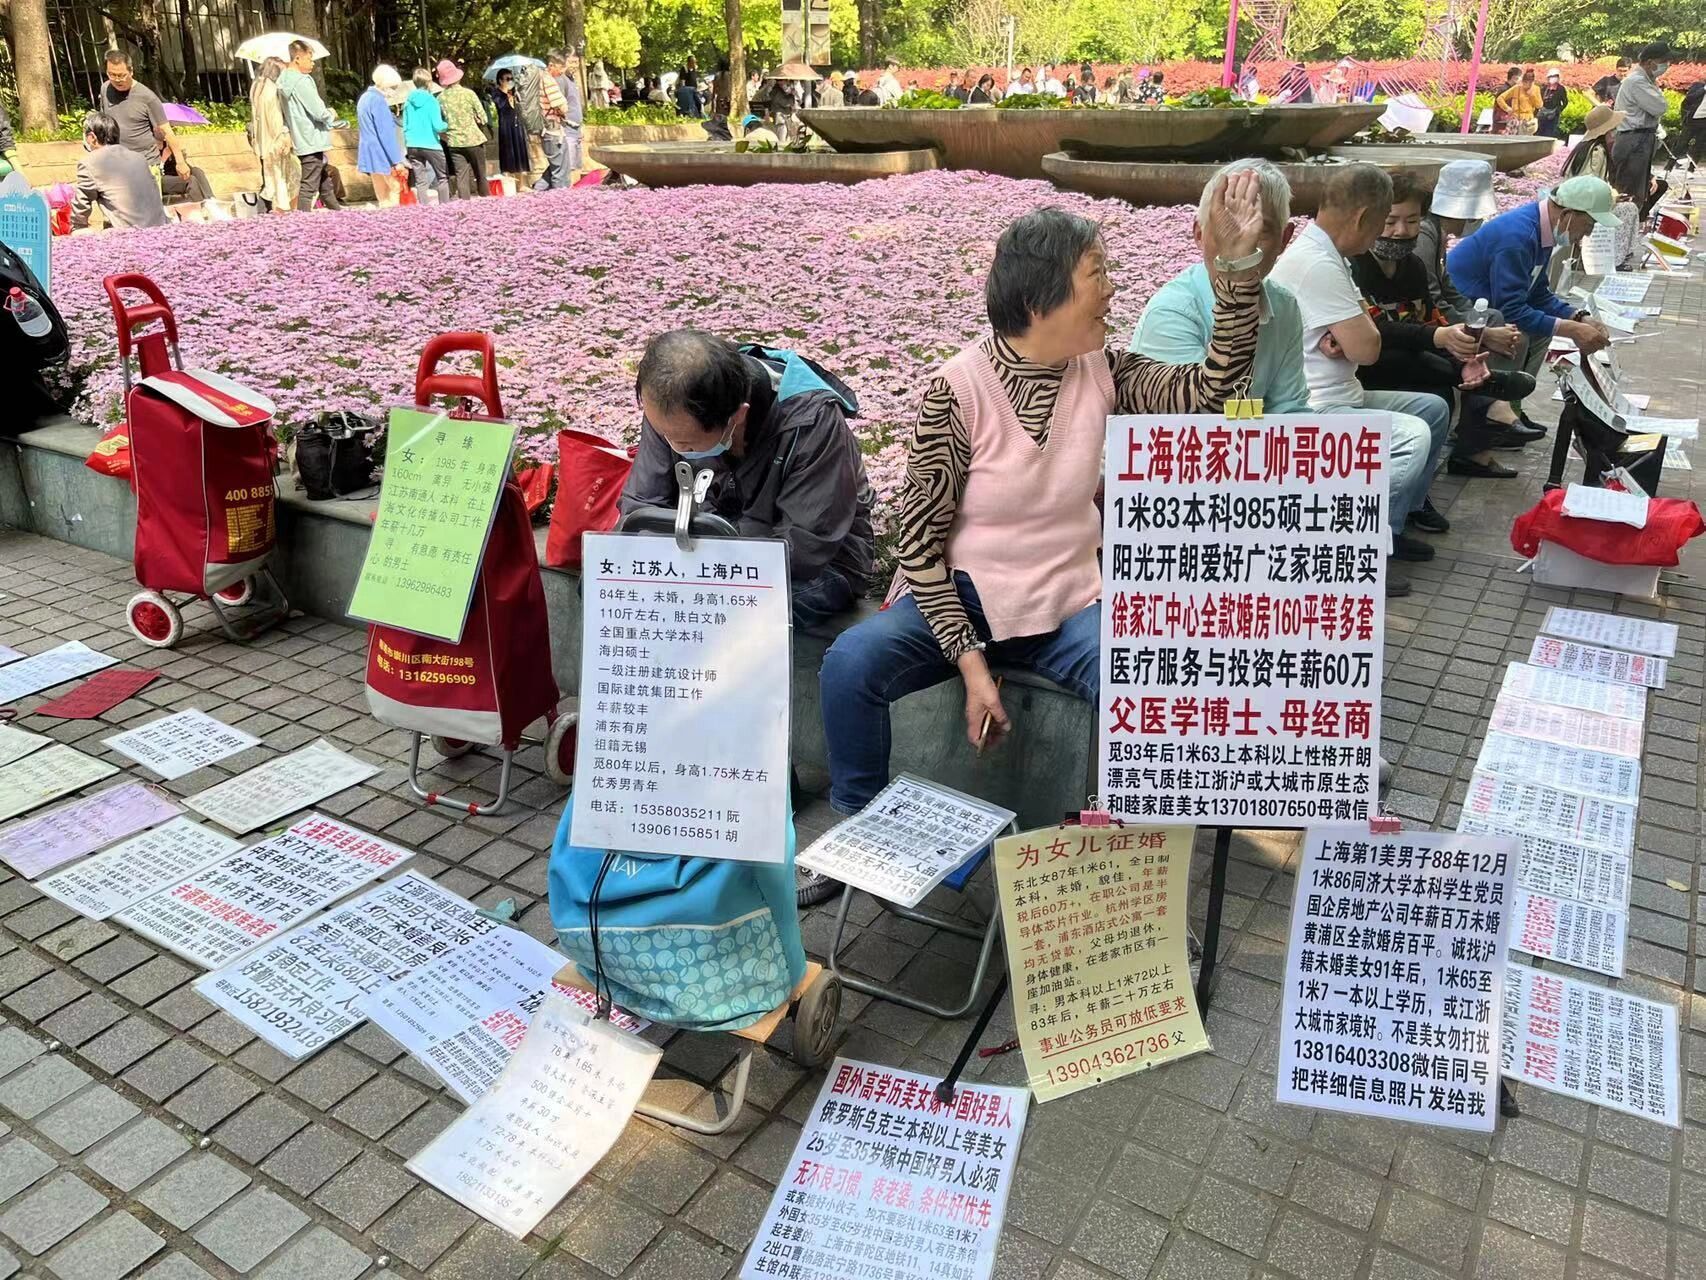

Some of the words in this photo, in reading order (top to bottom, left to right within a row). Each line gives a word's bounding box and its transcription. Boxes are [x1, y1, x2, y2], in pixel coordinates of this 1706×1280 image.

[436, 456, 457, 470] 1985
[475, 462, 497, 477] 身高
[1117, 425, 1382, 485] 上海徐家汇帅哥90年
[391, 467, 422, 481] 160cm
[463, 478, 493, 494] 无小孩
[225, 489, 248, 502] 400
[388, 485, 435, 503] 江苏南通人
[440, 493, 459, 506] 本科
[467, 497, 487, 512] 在上
[384, 502, 483, 529] 海文化传播公司工作
[1113, 492, 1380, 534] 1米83本科985硕士澳洲
[381, 518, 427, 538] 年薪十几万
[442, 546, 473, 566] 有责任
[1112, 543, 1378, 584] 阳光开朗爱好广泛家境殷实
[599, 588, 758, 608] 84年生，未婚，身高1.65米
[600, 607, 727, 625] 110斤左右，肤白文静
[1111, 590, 1374, 642] 徐家汇中心全款婚房160平等多套
[599, 626, 704, 643] 全国重点大学本科
[598, 644, 650, 660] 海归硕士
[598, 663, 717, 683] 一级注册建筑设计师
[1109, 646, 1373, 689] 医疗服务与投资年薪60万
[597, 682, 703, 701] 国际建筑集团工作
[596, 700, 648, 716] 年薪较丰
[1108, 696, 1373, 740] 父医学博士、母经商
[595, 720, 648, 735] 浦东有房
[594, 738, 647, 754] 祖籍无锡
[1108, 741, 1372, 768] 觅93年后1米63上本科以上性格开朗
[593, 757, 768, 783] 觅80年以后，身高1.75米左右
[1107, 767, 1370, 794] 漂亮气质佳江浙沪或大城市原生态
[591, 776, 659, 793] 优秀男青年
[1107, 793, 1369, 821] 和睦家庭美女13701807650母微信
[631, 822, 720, 841] 13906155851
[725, 829, 738, 843] 胡
[1015, 832, 1167, 870] 为女儿征婚
[1315, 839, 1508, 876] 上海第1美男子88年12月
[1312, 867, 1504, 906] 1米86同济大学本科学生党员
[1306, 895, 1501, 935] 国企房地产公司年薪百万未婚
[1303, 921, 1496, 963] 黄浦区全款婚房百平。诚找沪
[1300, 949, 1493, 993] 籍未婚美女91年后，1米65至
[235, 958, 355, 1036] 好勤劳无不良习惯
[1039, 995, 1187, 1054] 事业公务员可放低要求
[1294, 1006, 1490, 1055] 大城市家境好。不是美女勿打扰
[1293, 1039, 1489, 1086] 13816403308微信同号
[1292, 1066, 1486, 1118] 把祥细信息照片发给我
[818, 1098, 1006, 1160] 俄罗斯乌克兰本科以上等美女
[806, 1129, 1001, 1193] 25岁至35岁嫁中国好男人必须
